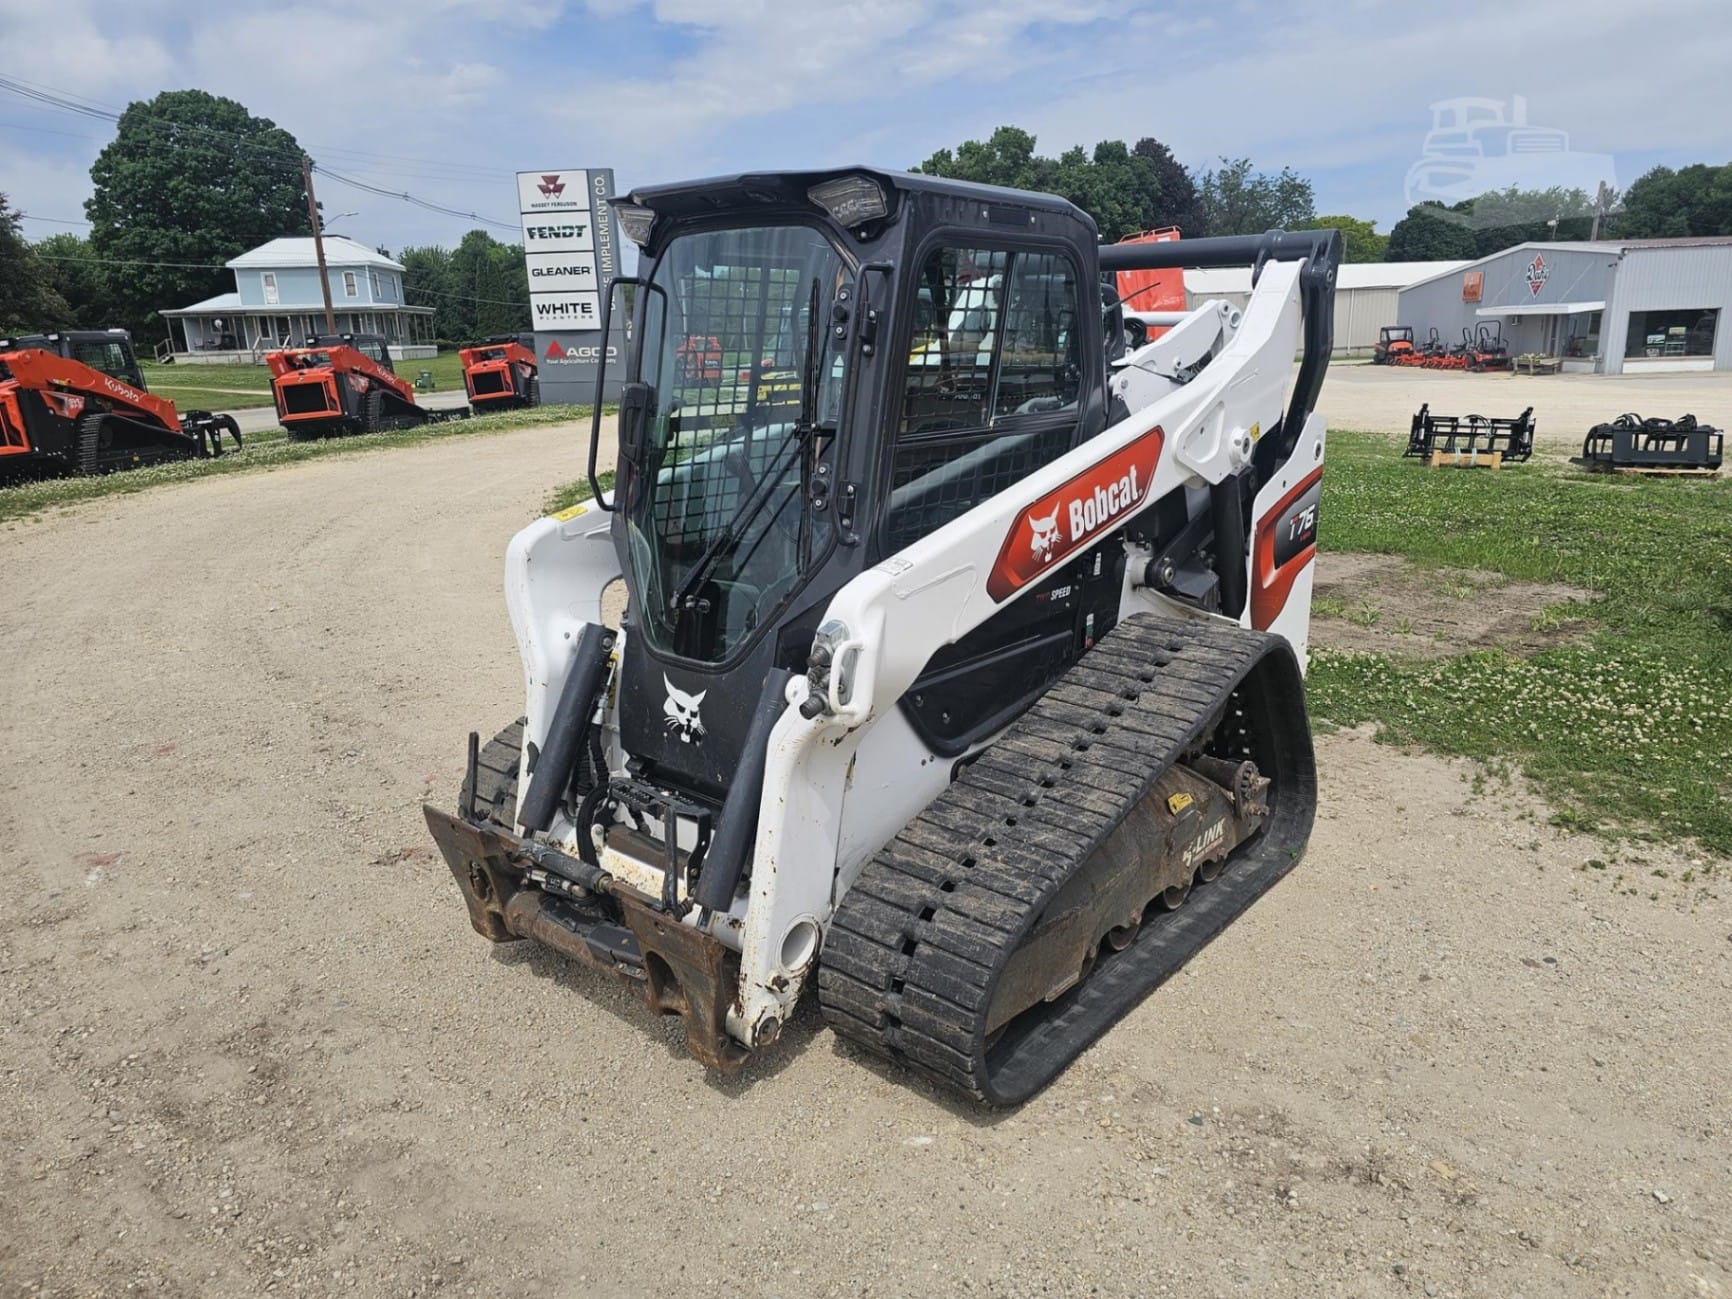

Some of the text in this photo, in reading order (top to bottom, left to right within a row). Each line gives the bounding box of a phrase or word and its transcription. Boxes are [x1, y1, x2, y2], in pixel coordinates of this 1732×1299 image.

[594, 174, 606, 195] CO.
[526, 225, 587, 239] FENDT
[596, 198, 613, 272] IMPLEMENT
[532, 266, 591, 277] GLEANER
[536, 303, 592, 314] WHITE
[104, 378, 140, 402] Kubota
[1069, 464, 1139, 542] Bobcat
[1289, 503, 1316, 541] T76
[1050, 585, 1072, 601] SPEED
